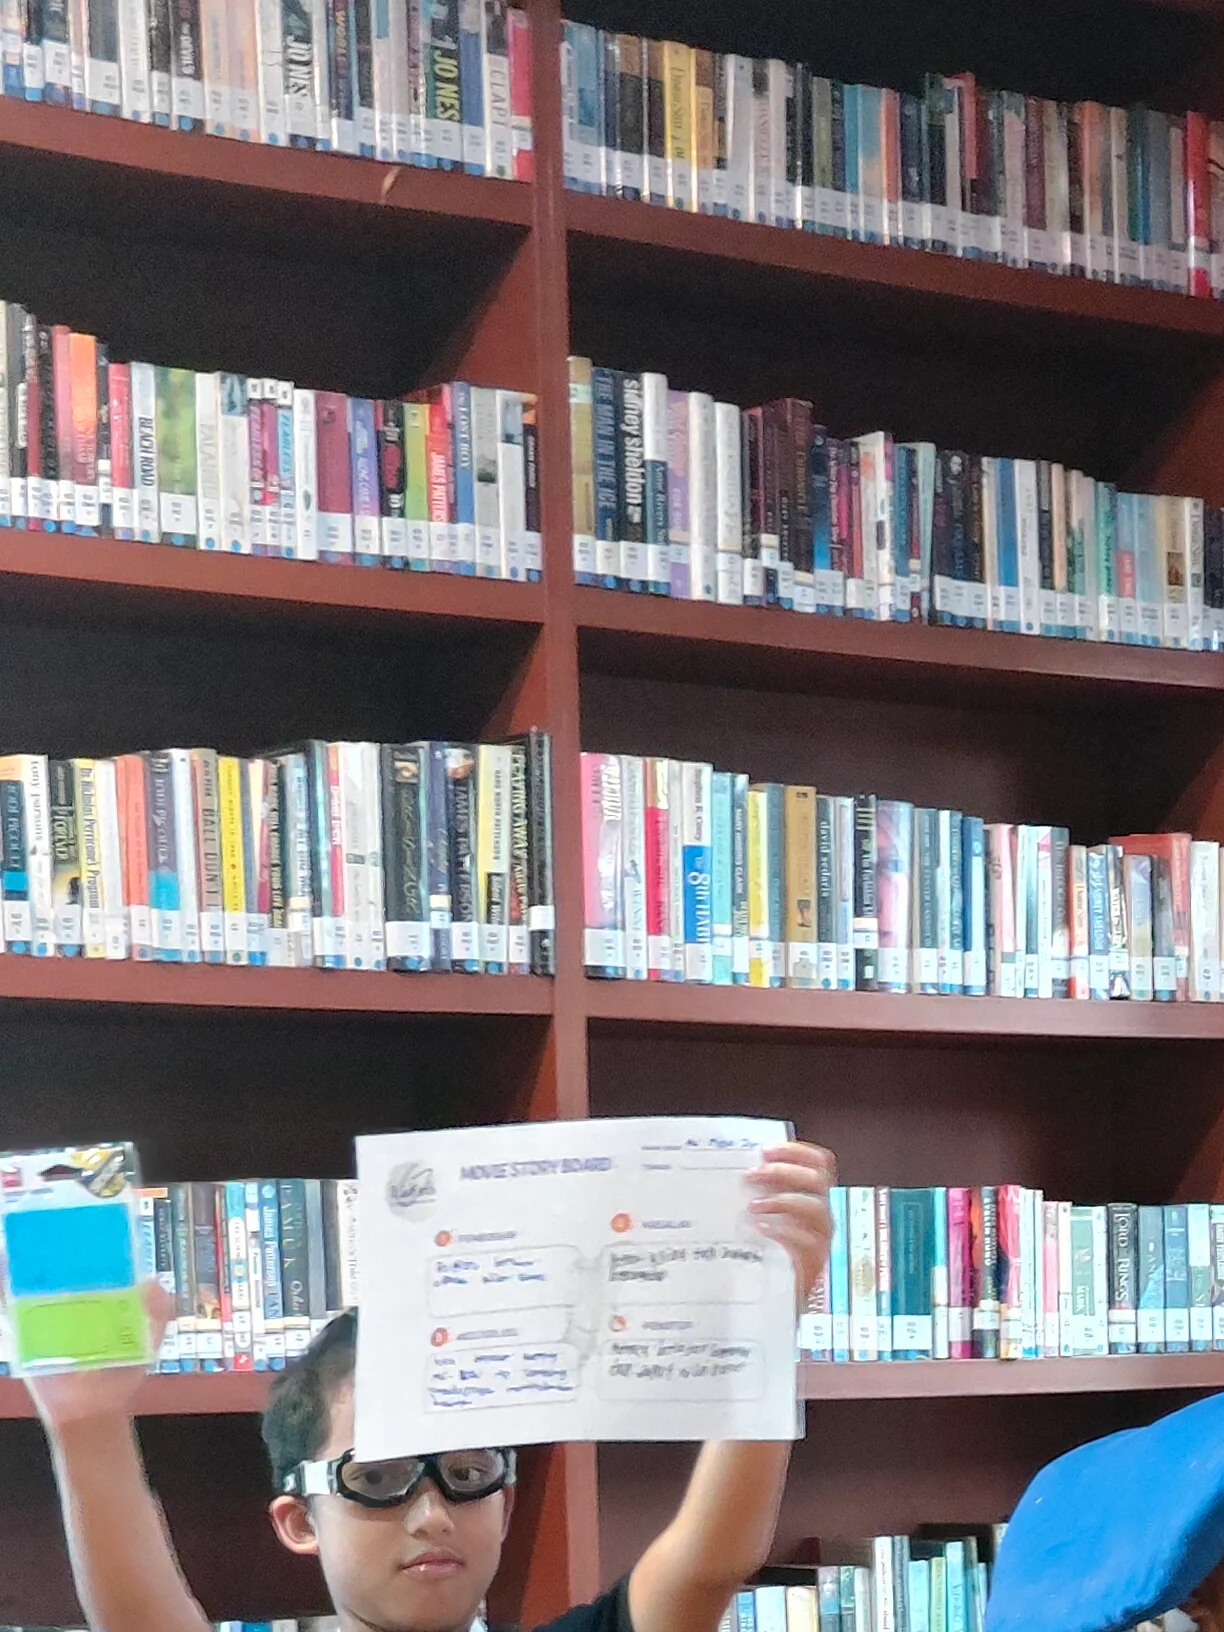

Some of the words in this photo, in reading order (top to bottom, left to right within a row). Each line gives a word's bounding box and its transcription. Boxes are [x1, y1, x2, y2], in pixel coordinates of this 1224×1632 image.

[459, 407, 471, 441] LOST
[620, 379, 643, 435] sidney
[138, 417, 155, 454] BEACH
[139, 457, 155, 487] ROAD
[624, 437, 646, 504] sheldon
[30, 761, 43, 788] tony
[30, 794, 44, 840] parsons
[202, 808, 216, 843] BALL
[820, 821, 832, 853] david
[820, 856, 832, 898] sedaris
[263, 1206, 278, 1238] James
[1114, 1213, 1130, 1247] LORD
[263, 1241, 279, 1287] Patterson
[1115, 1258, 1131, 1302] RINGS
